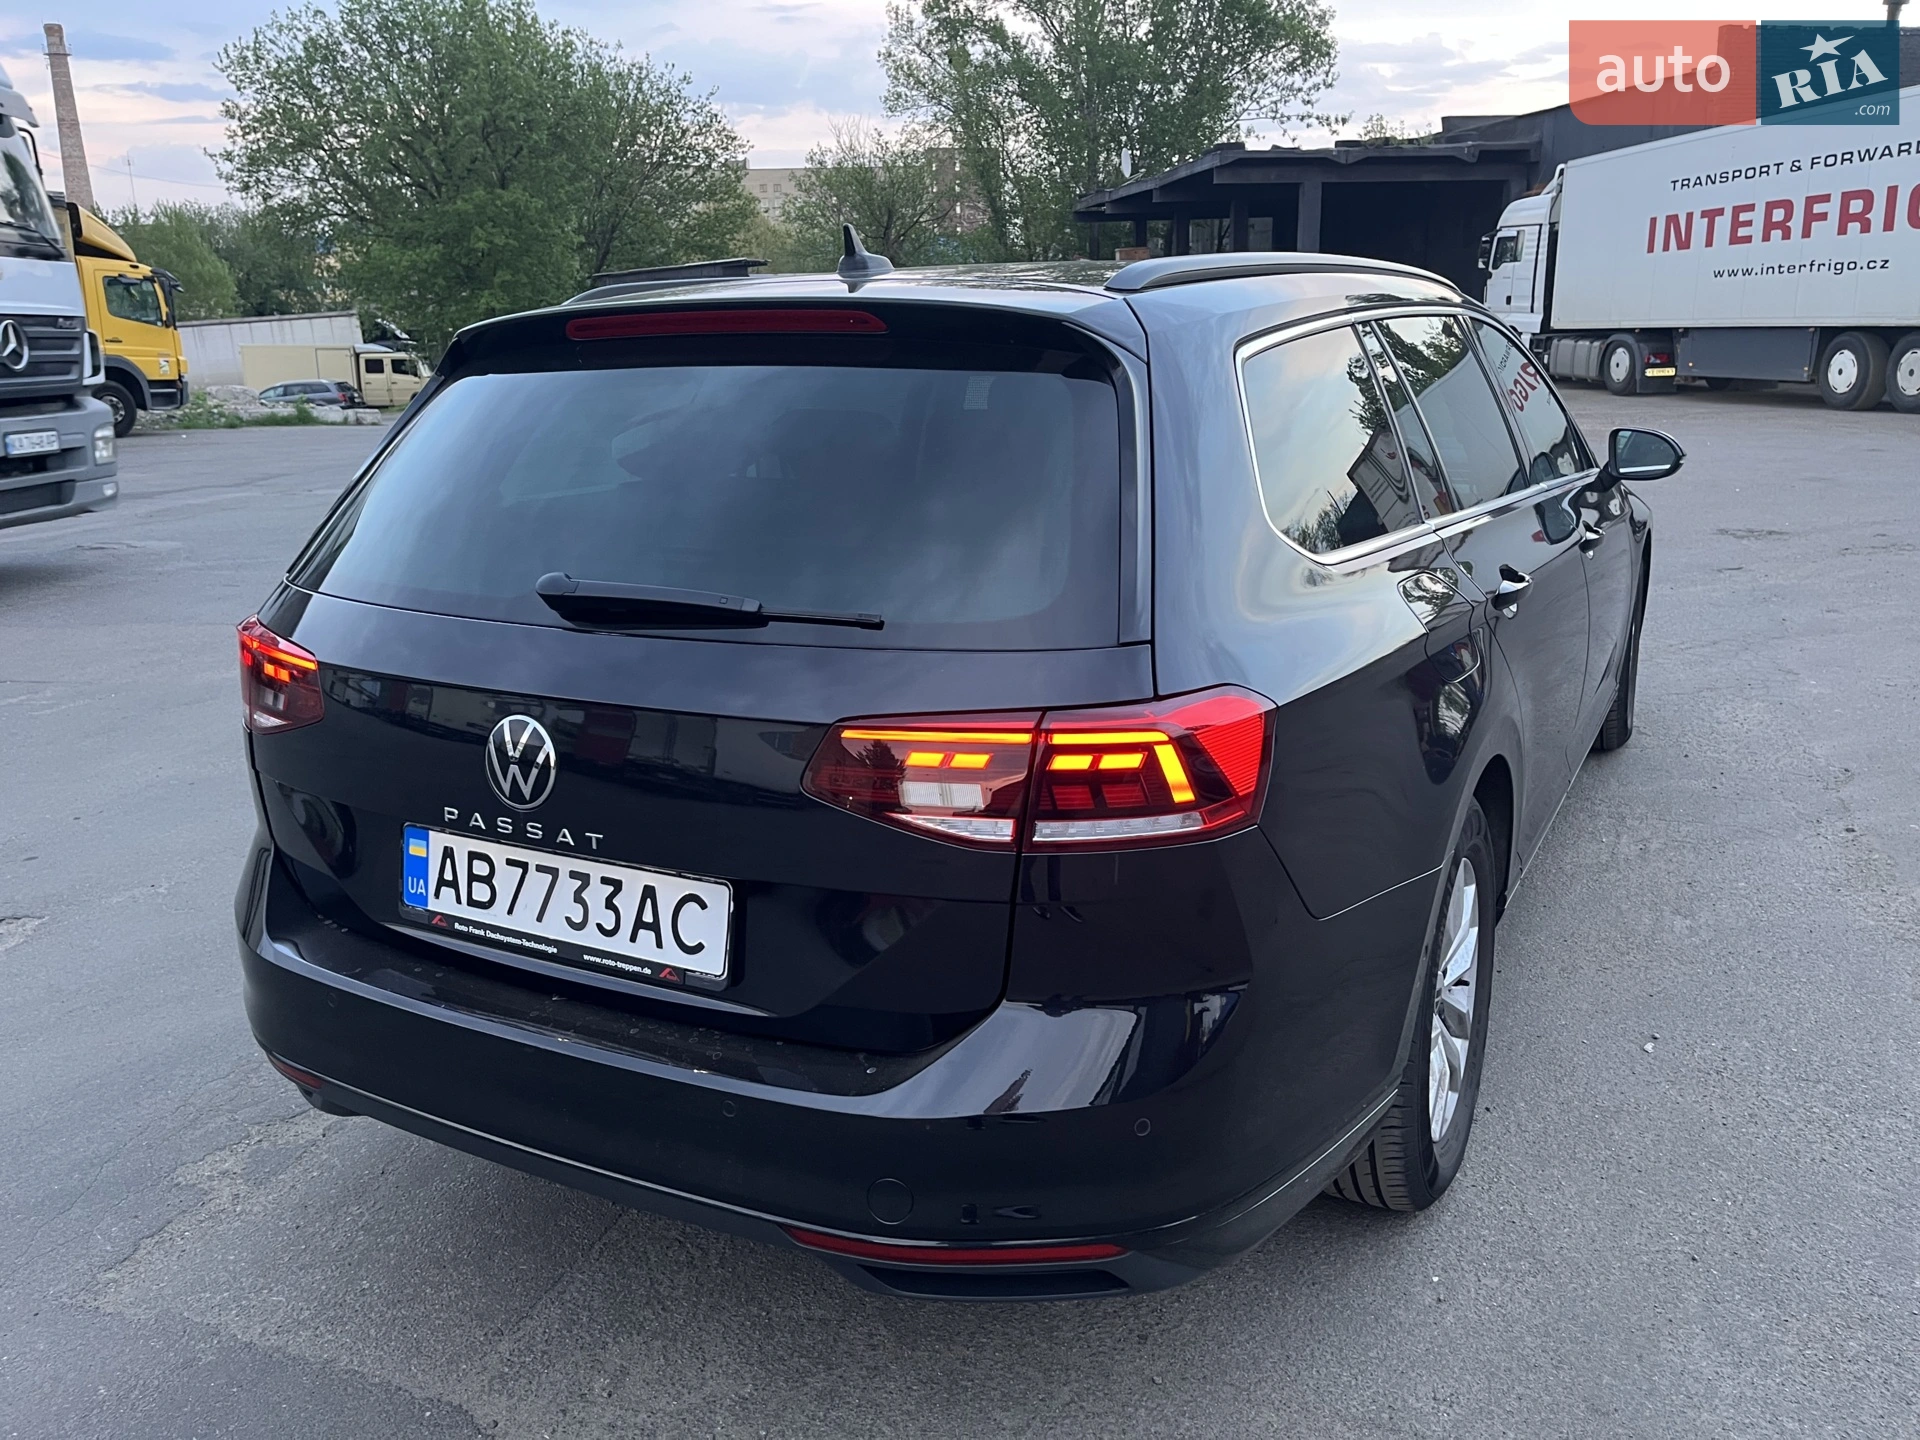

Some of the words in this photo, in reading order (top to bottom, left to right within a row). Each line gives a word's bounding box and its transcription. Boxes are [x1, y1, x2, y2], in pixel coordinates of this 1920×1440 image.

[1670, 161, 1784, 191] TRANSPORT
[1789, 159, 1802, 172] &
[1713, 258, 1890, 279] www.interfrigo.cz
[444, 807, 604, 850] PASSAT
[408, 875, 427, 897] UA
[434, 845, 709, 956] AB7733AC
[454, 922, 469, 932] Roto
[468, 925, 486, 937] Frank
[583, 954, 652, 975] www.roto-treppen.de
